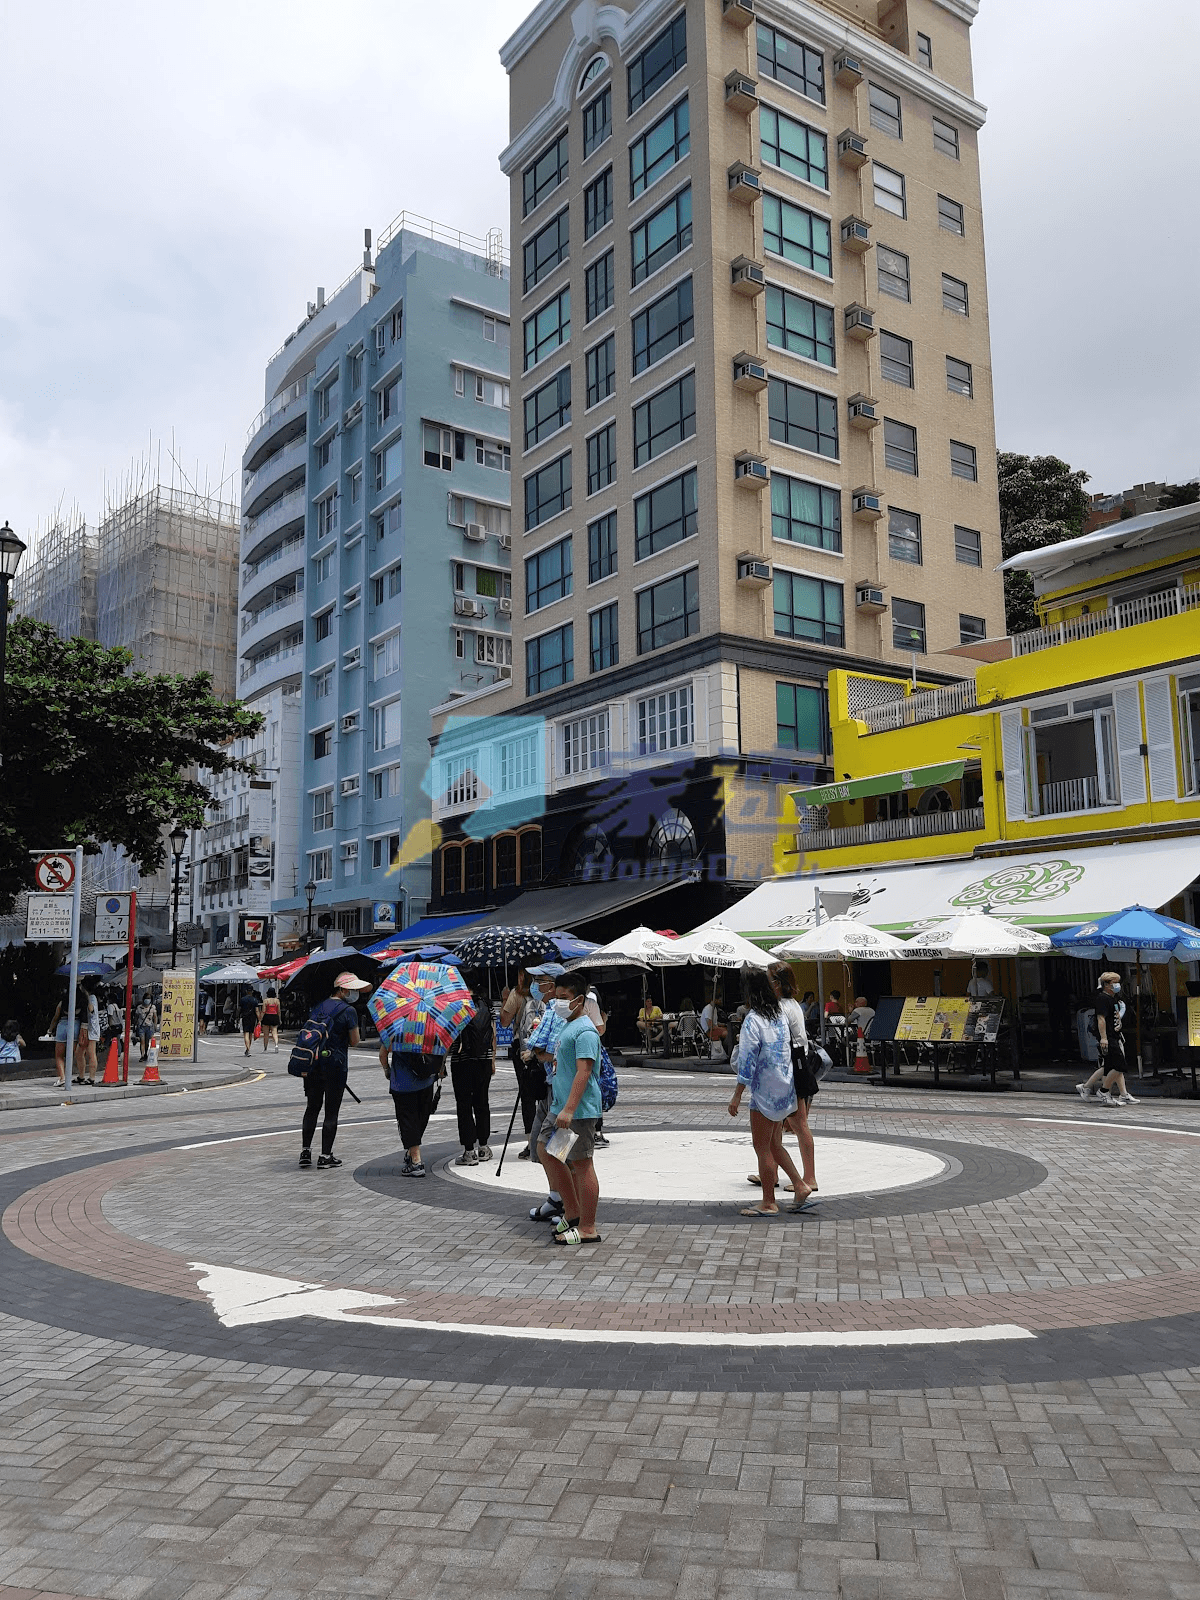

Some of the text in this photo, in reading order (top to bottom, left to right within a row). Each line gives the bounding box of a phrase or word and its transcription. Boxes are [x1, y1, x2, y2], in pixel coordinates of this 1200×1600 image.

[819, 785, 851, 802] BEESY BAY
[117, 917, 123, 926] 7
[116, 930, 127, 939] 12
[248, 922, 262, 941] 7
[1112, 940, 1166, 949] BLUE GIRL
[847, 949, 890, 958] SOMERSBY
[902, 948, 943, 957] SOMERSBY
[697, 954, 737, 967] SOMERSBY
